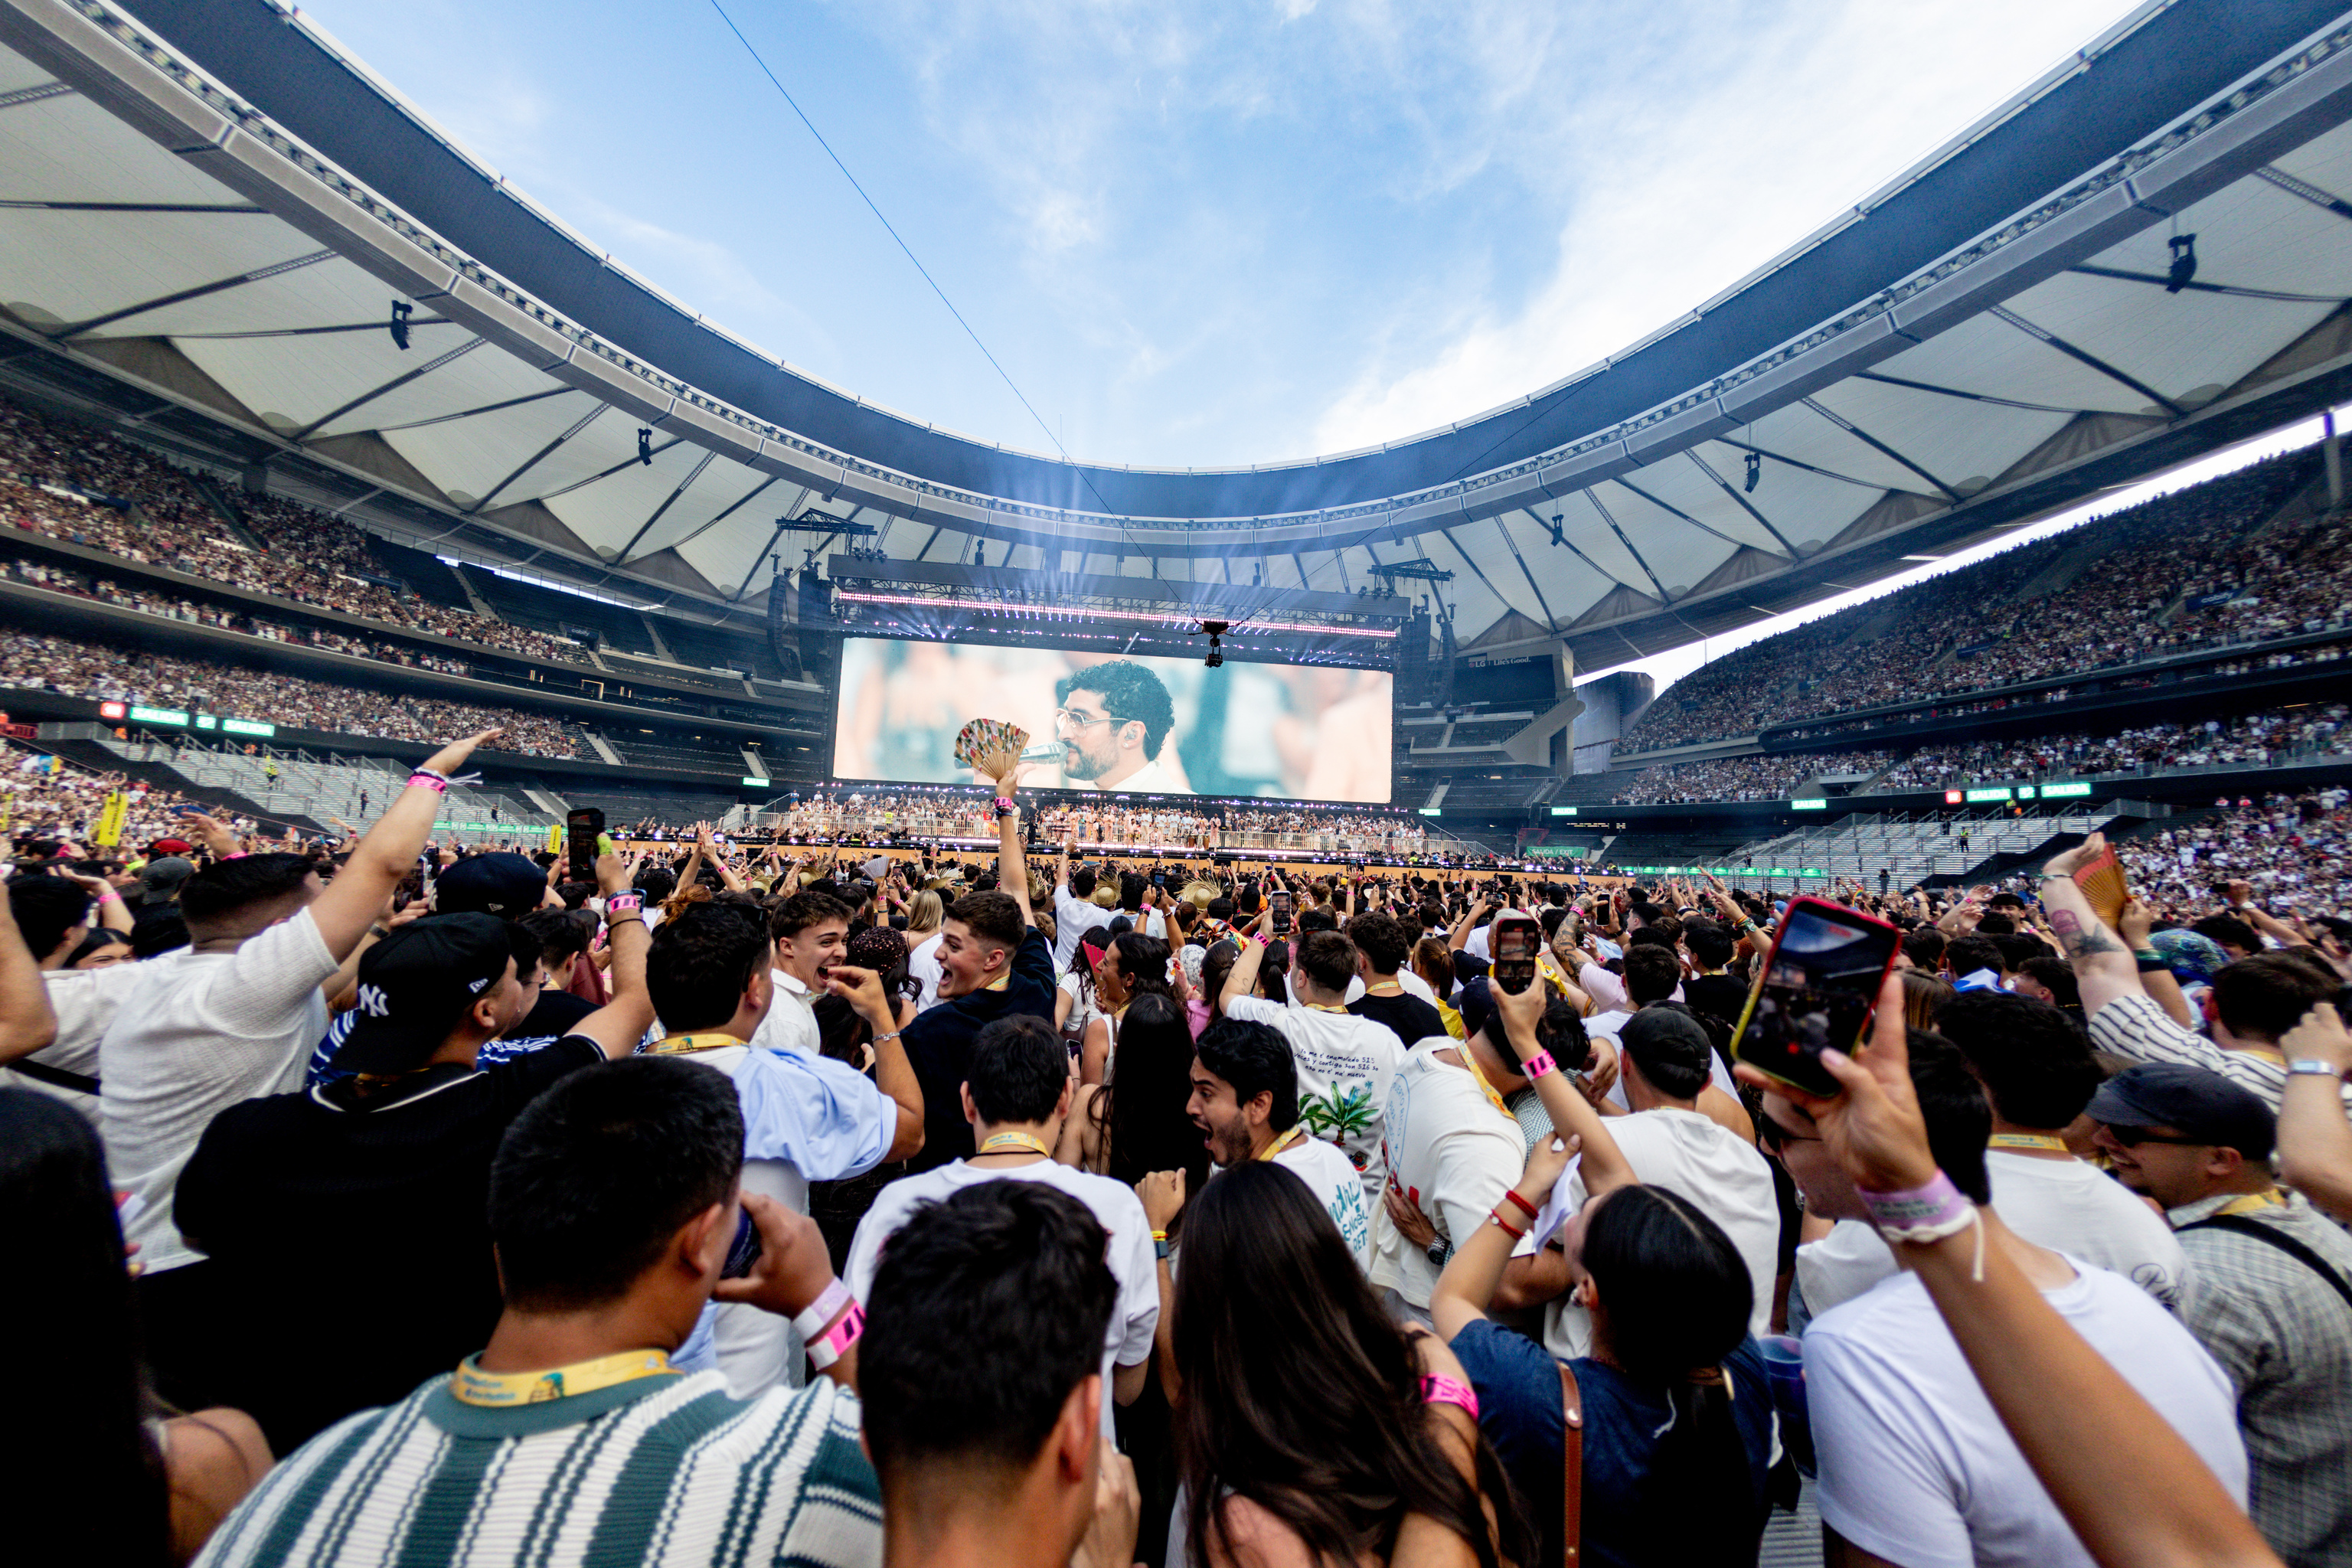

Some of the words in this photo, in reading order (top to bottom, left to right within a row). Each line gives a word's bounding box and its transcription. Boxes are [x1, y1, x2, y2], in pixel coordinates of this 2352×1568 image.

[133, 708, 185, 724] SALIDA
[225, 720, 272, 735] SALIDA
[1969, 790, 2009, 800] SALIDA
[2044, 785, 2089, 795] SALIDA
[1793, 800, 1825, 809] SALIDA
[1326, 1054, 1359, 1063] enamorado
[1318, 1060, 1342, 1069] contigo
